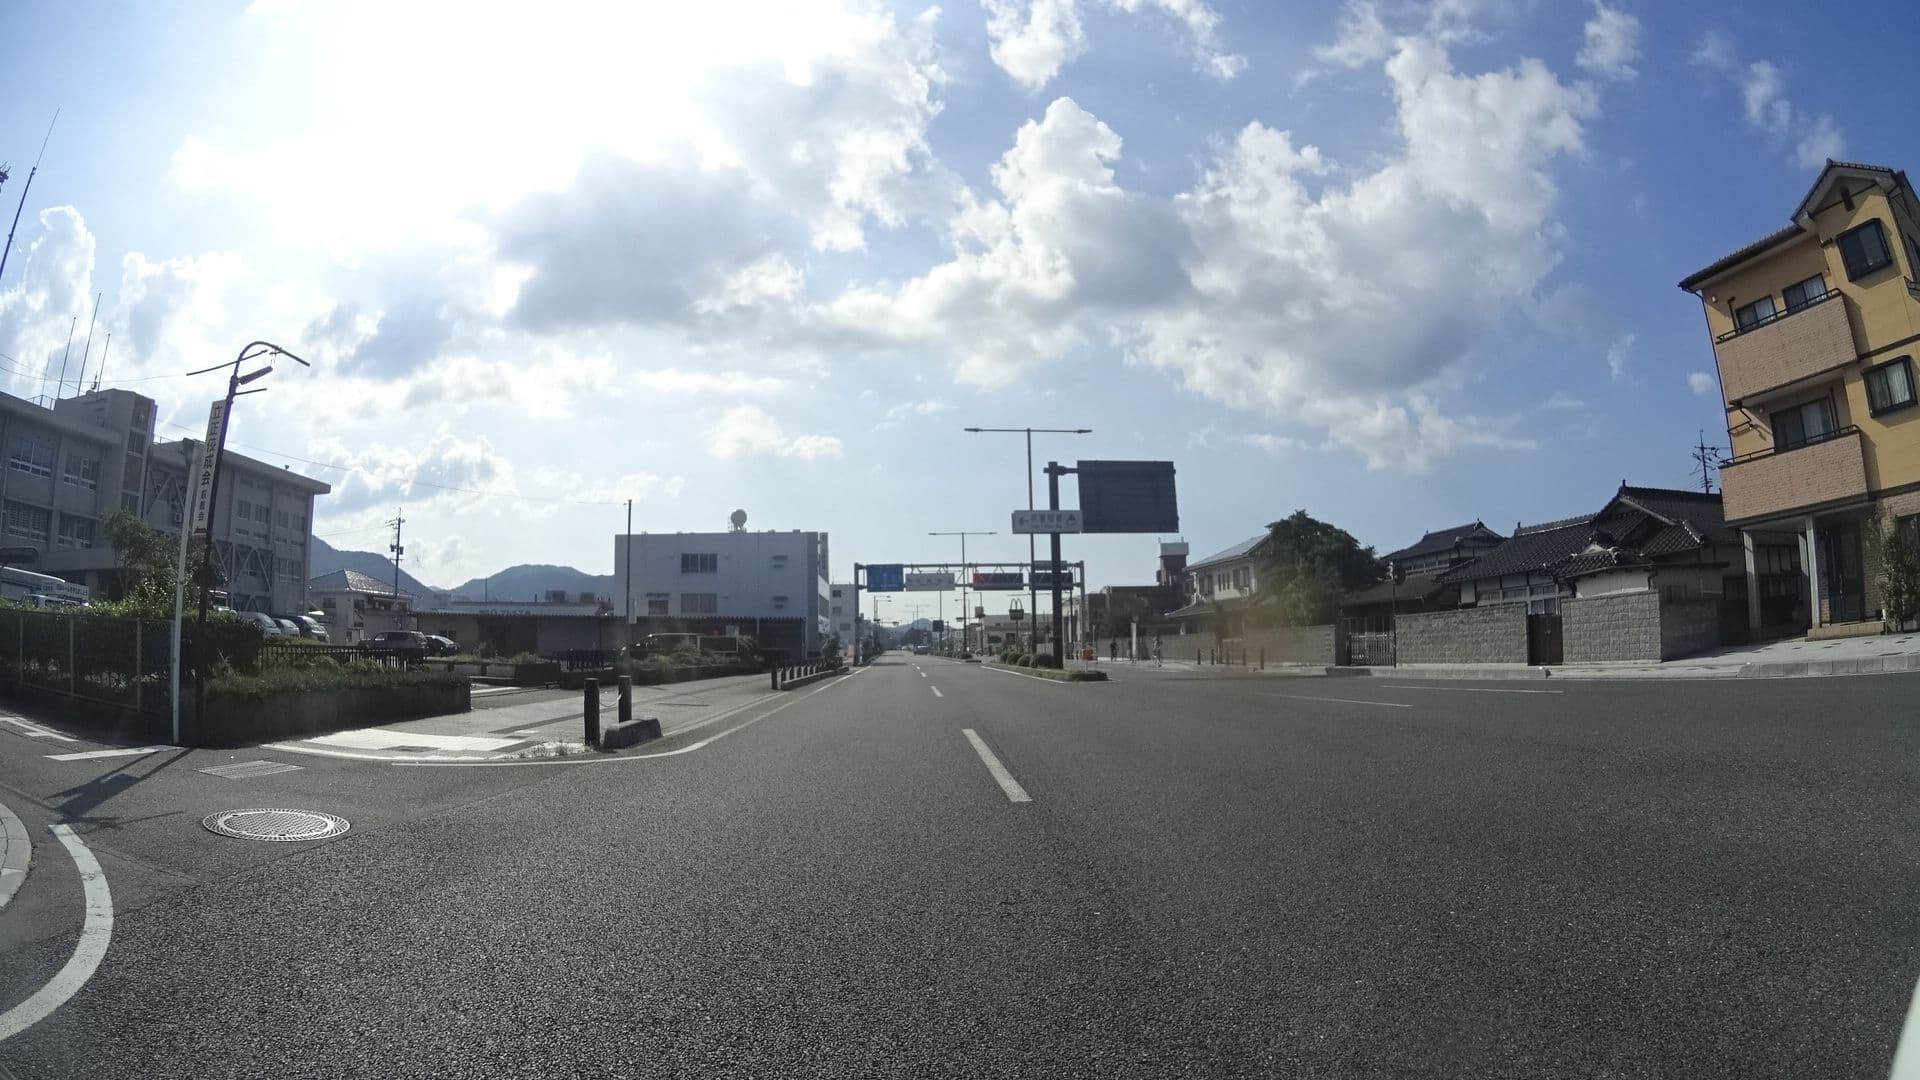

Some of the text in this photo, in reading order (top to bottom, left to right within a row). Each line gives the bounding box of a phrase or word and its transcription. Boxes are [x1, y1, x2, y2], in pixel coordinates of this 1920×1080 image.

[201, 405, 223, 486] 立正佼成会
